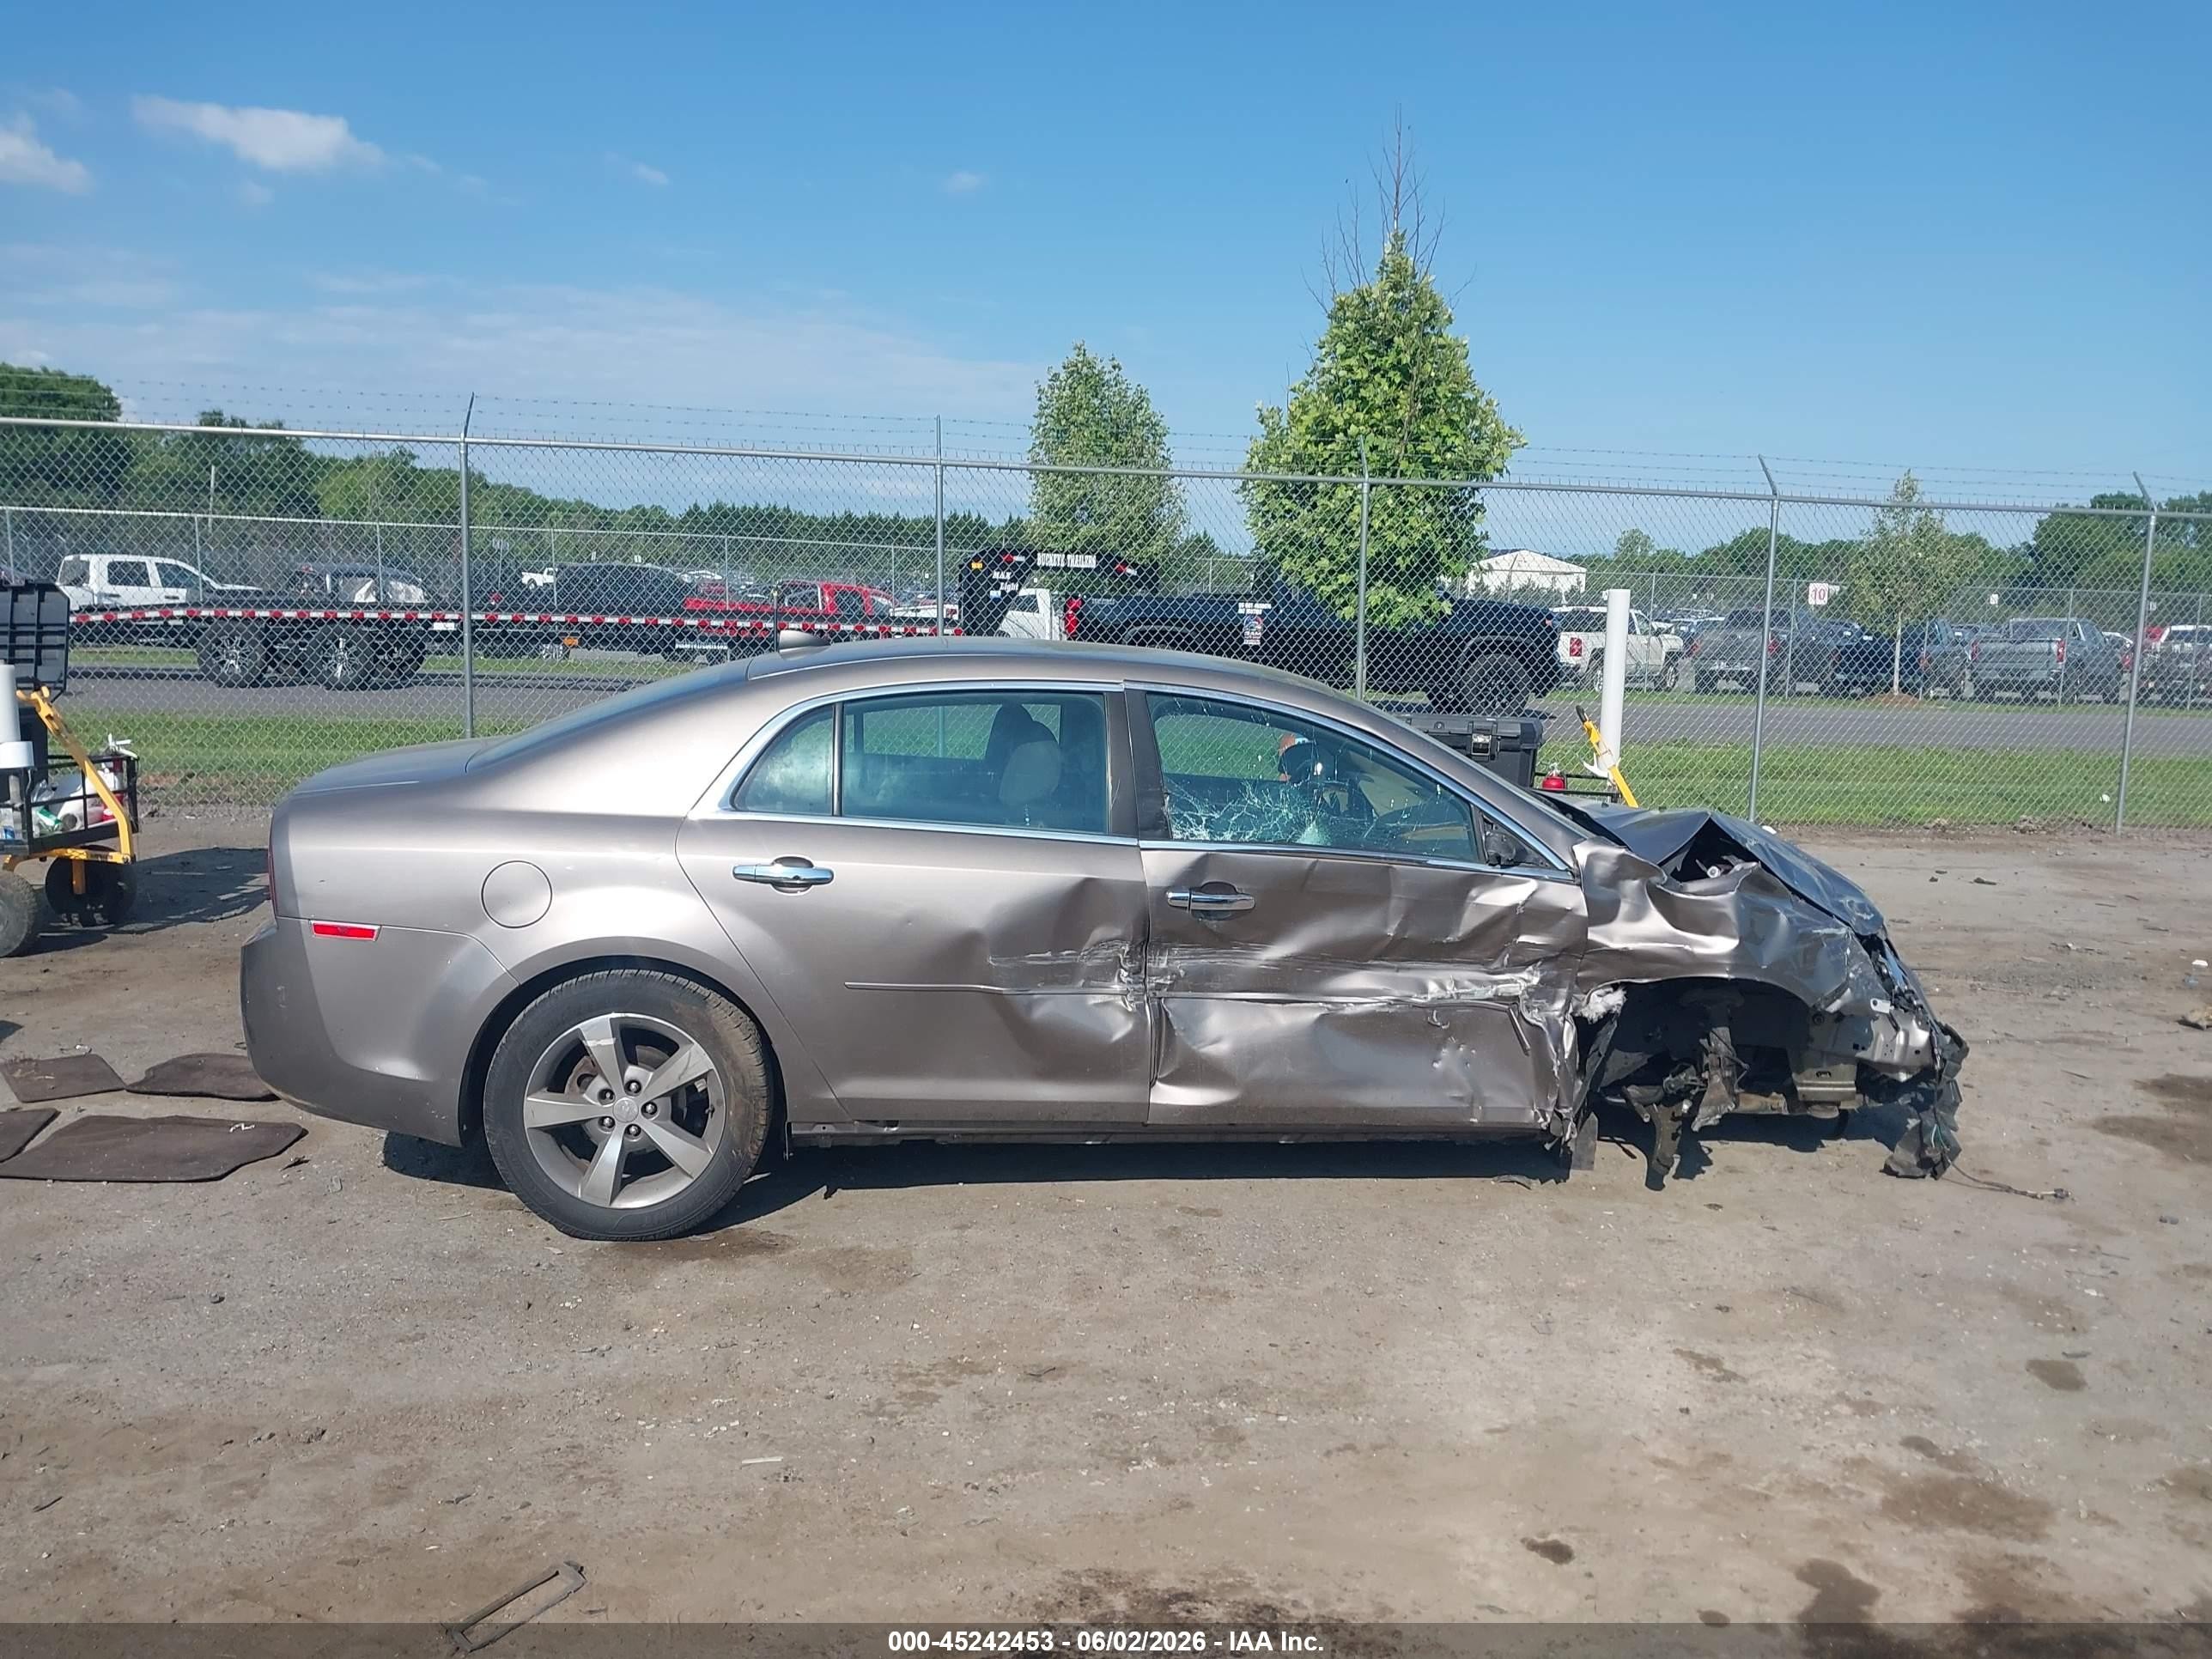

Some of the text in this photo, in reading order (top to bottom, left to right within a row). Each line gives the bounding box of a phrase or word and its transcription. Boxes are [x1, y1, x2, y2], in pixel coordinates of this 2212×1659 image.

[1036, 552, 1097, 568] BUCKEYE TRAILERS
[992, 570, 1012, 580] MAX
[1000, 581, 1019, 592] Light
[1812, 588, 1826, 600] 10
